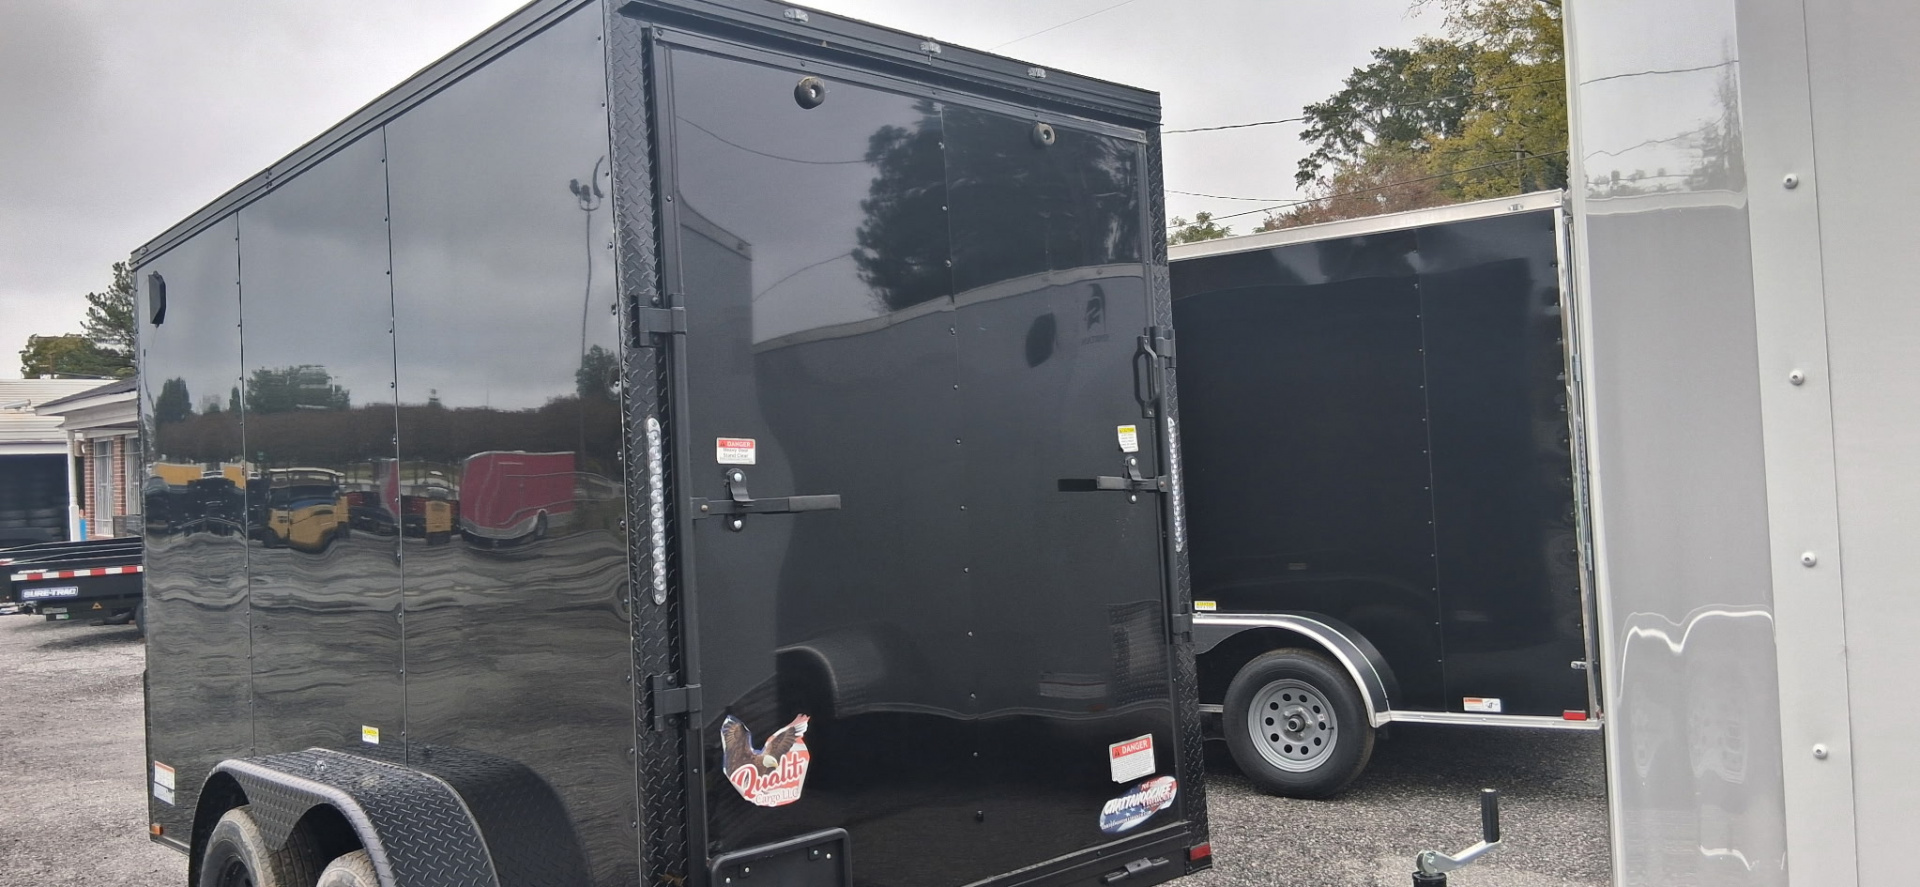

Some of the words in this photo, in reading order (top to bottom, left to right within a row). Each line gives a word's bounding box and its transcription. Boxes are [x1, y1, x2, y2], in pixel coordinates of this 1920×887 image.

[1122, 740, 1148, 754] DANGER
[756, 792, 781, 805] Cargo
[782, 787, 800, 799] LLC
